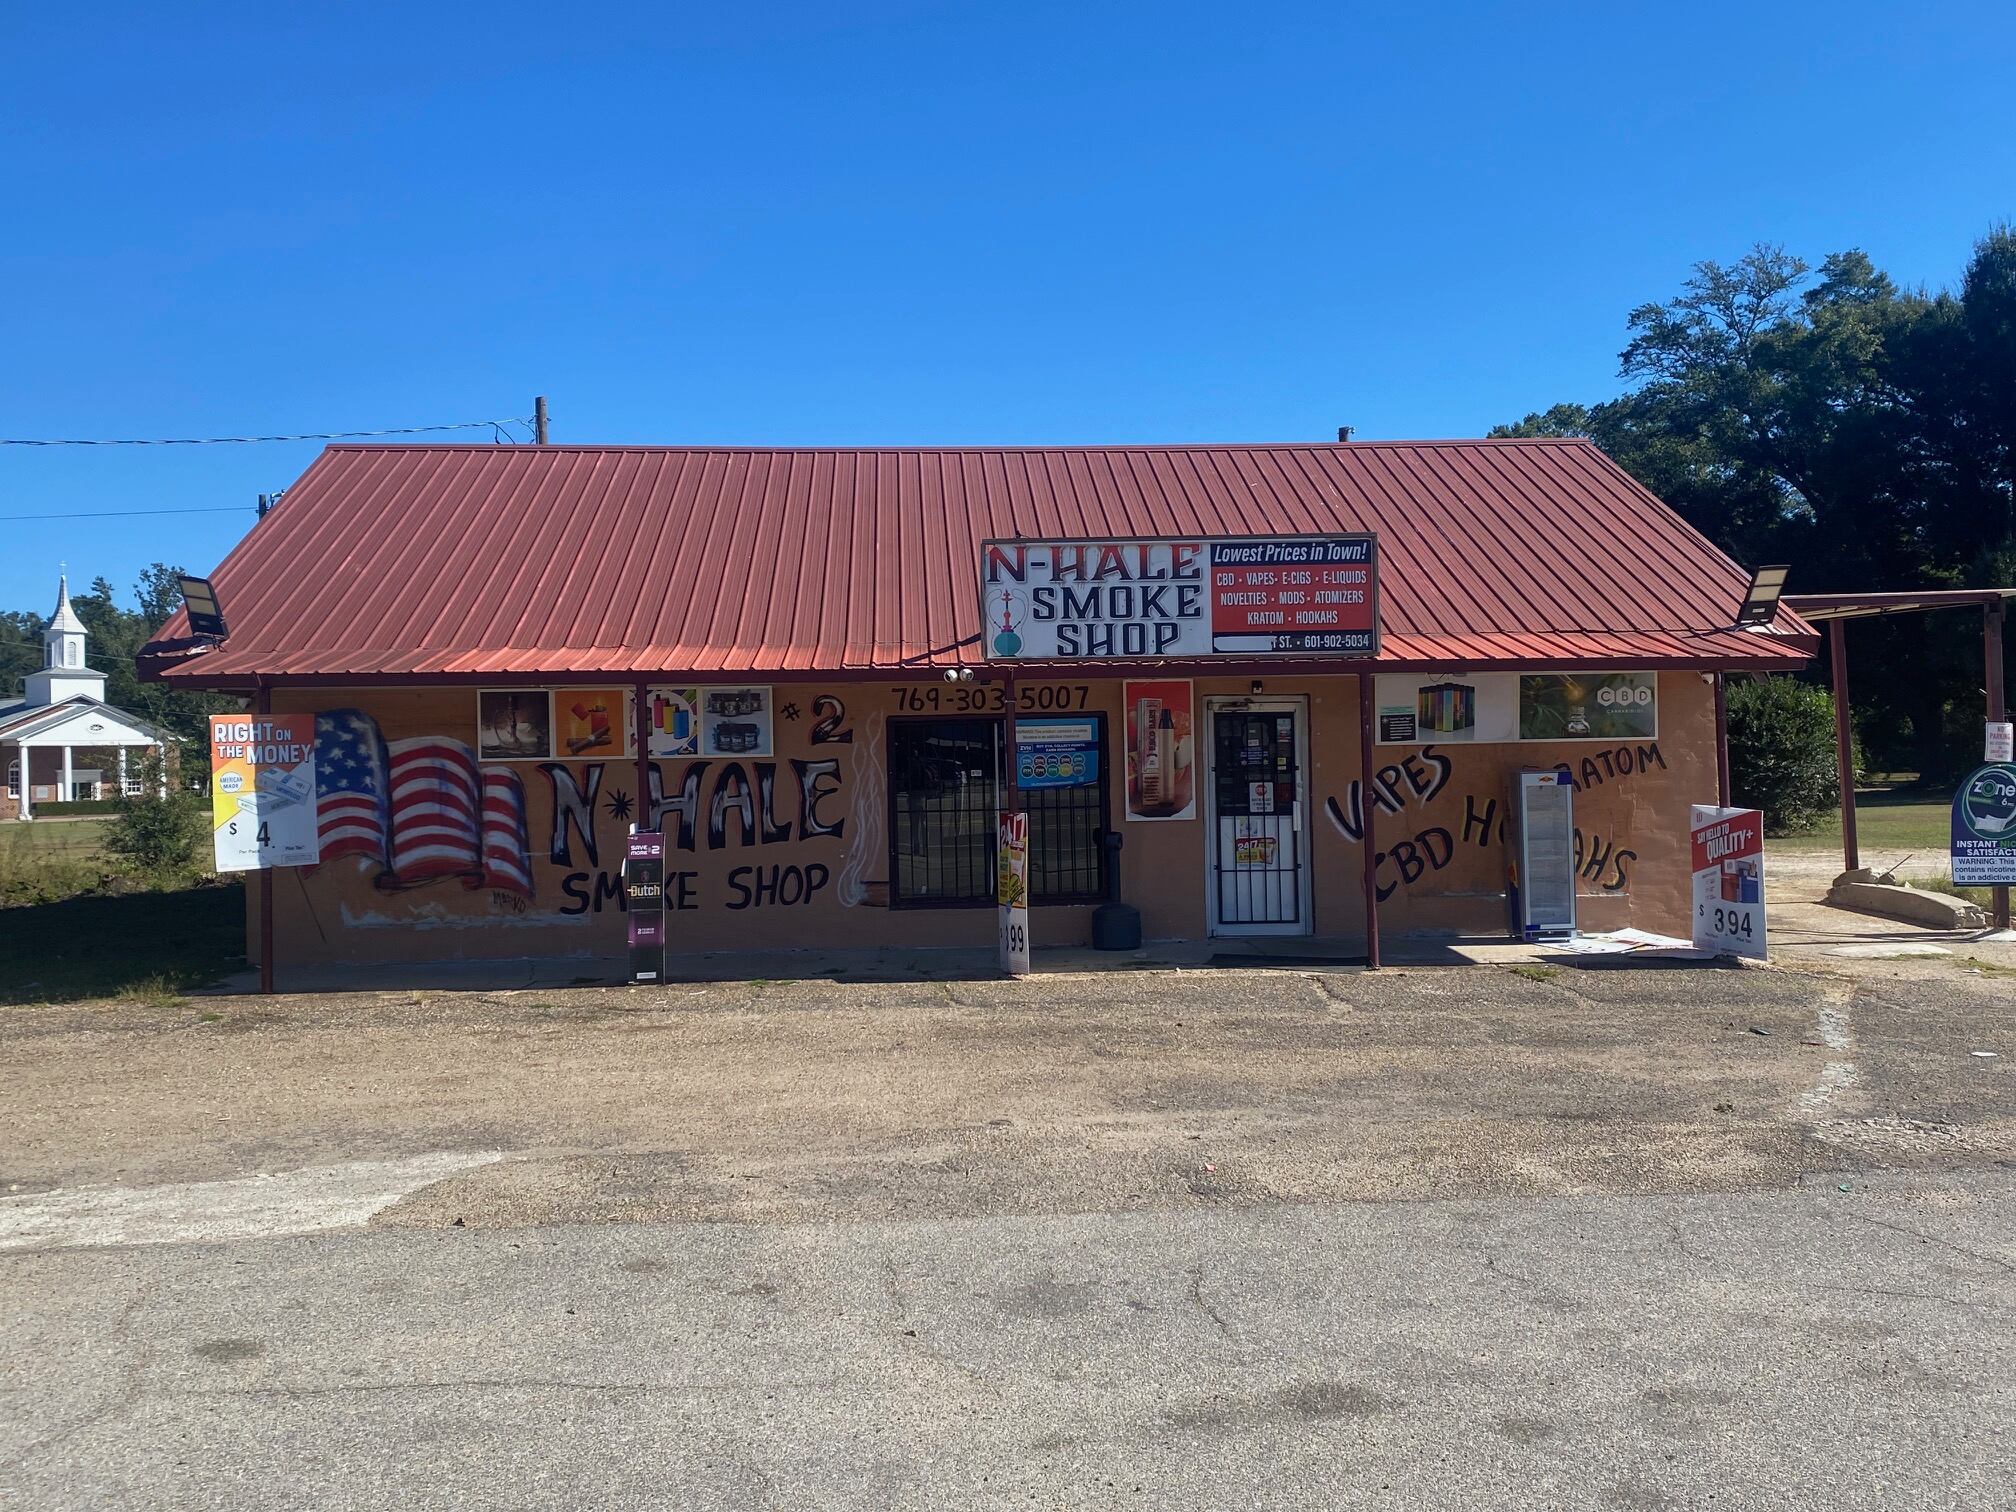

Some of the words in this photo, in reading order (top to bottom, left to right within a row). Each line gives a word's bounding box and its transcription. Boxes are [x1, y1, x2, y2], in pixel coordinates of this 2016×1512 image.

[1214, 545, 1264, 562] Lowest
[1265, 544, 1308, 562] Prices
[1310, 542, 1323, 561] in
[1328, 542, 1367, 561] Town!
[987, 544, 1200, 582] N-HALE
[1216, 573, 1235, 586] CBD
[1246, 572, 1274, 586] VAPES
[1282, 571, 1311, 585] E-CIGS
[1323, 571, 1367, 584] E-LIQUIDS
[1032, 584, 1201, 619] SMOKE
[1220, 592, 1267, 606] NOVELTIES
[1279, 591, 1305, 605] MODS
[1314, 591, 1364, 604] ATOMIZERS
[1247, 611, 1284, 625] KRATOM
[1296, 610, 1338, 624] HOOKAHS
[1056, 622, 1179, 656] SHOP
[1279, 636, 1293, 649] ST.
[1304, 635, 1369, 648] 601-902-5034
[891, 685, 1089, 711] 769-3035007
[214, 722, 274, 743] RIGHT
[276, 729, 291, 741] ON
[1989, 732, 2010, 740] PARKING
[217, 746, 243, 758] THE
[246, 744, 311, 764] MONEY
[219, 776, 243, 784] AMERICAN
[1325, 745, 1452, 843] VAPES
[1974, 781, 2016, 797] zone
[634, 758, 845, 852] HALE
[2001, 798, 2007, 806] 6
[1697, 832, 1706, 844] SAY
[1706, 826, 1721, 842] HELLO
[1721, 823, 1730, 835] TO
[651, 845, 660, 855] 2
[1956, 840, 1997, 848] INSTANT
[1374, 827, 1453, 902] CBD
[1958, 857, 1998, 865] WARNING:
[2000, 857, 2015, 865] This
[1955, 865, 1986, 873] contains
[1959, 873, 1966, 881] is
[1977, 873, 2008, 881] addictive
[560, 871, 698, 915] SMKE
[726, 863, 829, 910] SHOP
[630, 885, 660, 897] Dutch
[1699, 904, 1705, 916] $
